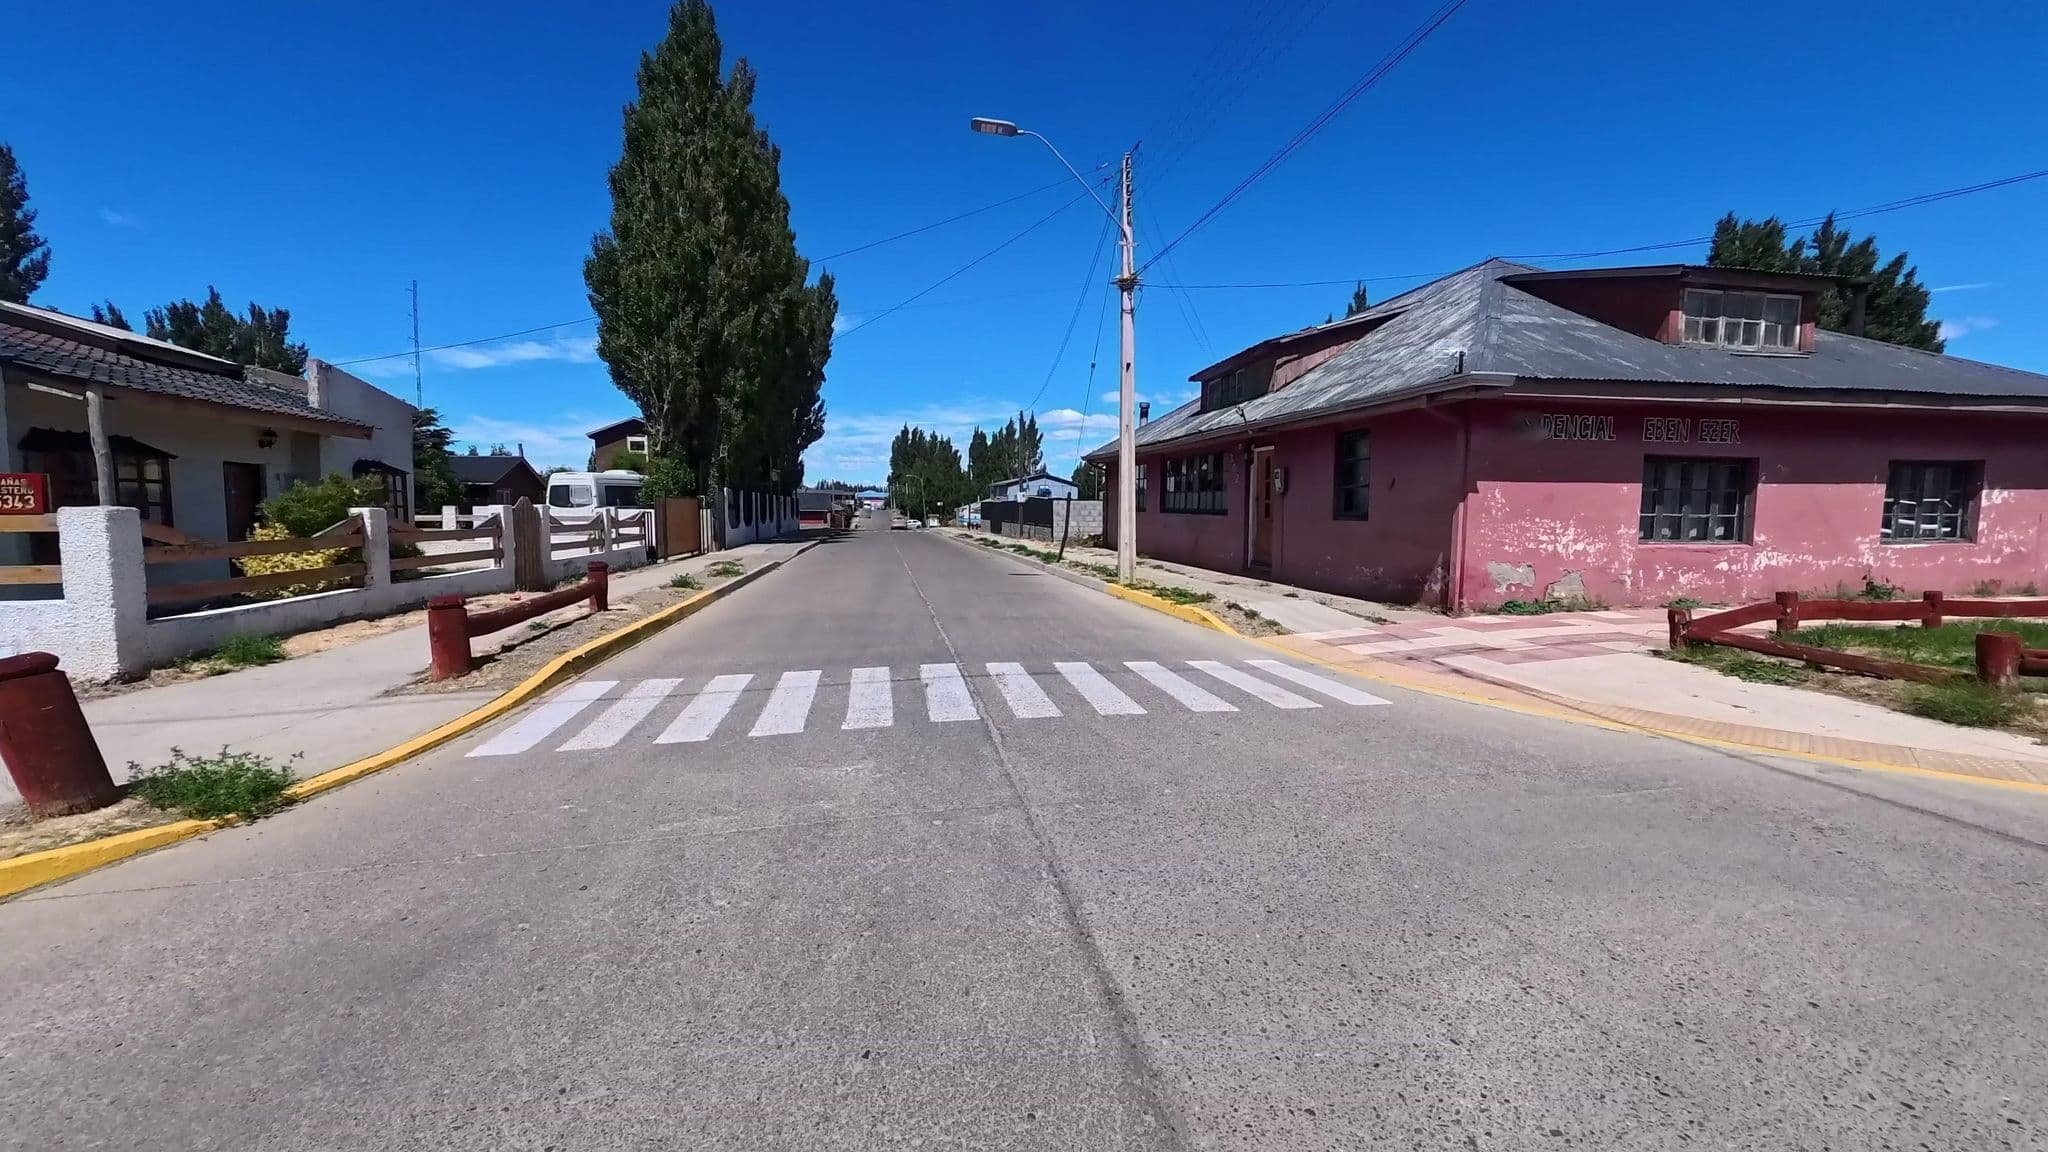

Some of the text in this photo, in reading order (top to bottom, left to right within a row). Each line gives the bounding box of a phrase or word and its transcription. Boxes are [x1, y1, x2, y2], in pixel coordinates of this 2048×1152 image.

[1514, 413, 1742, 444] DENCIAL EBEN EZER
[0, 495, 35, 509] 343
